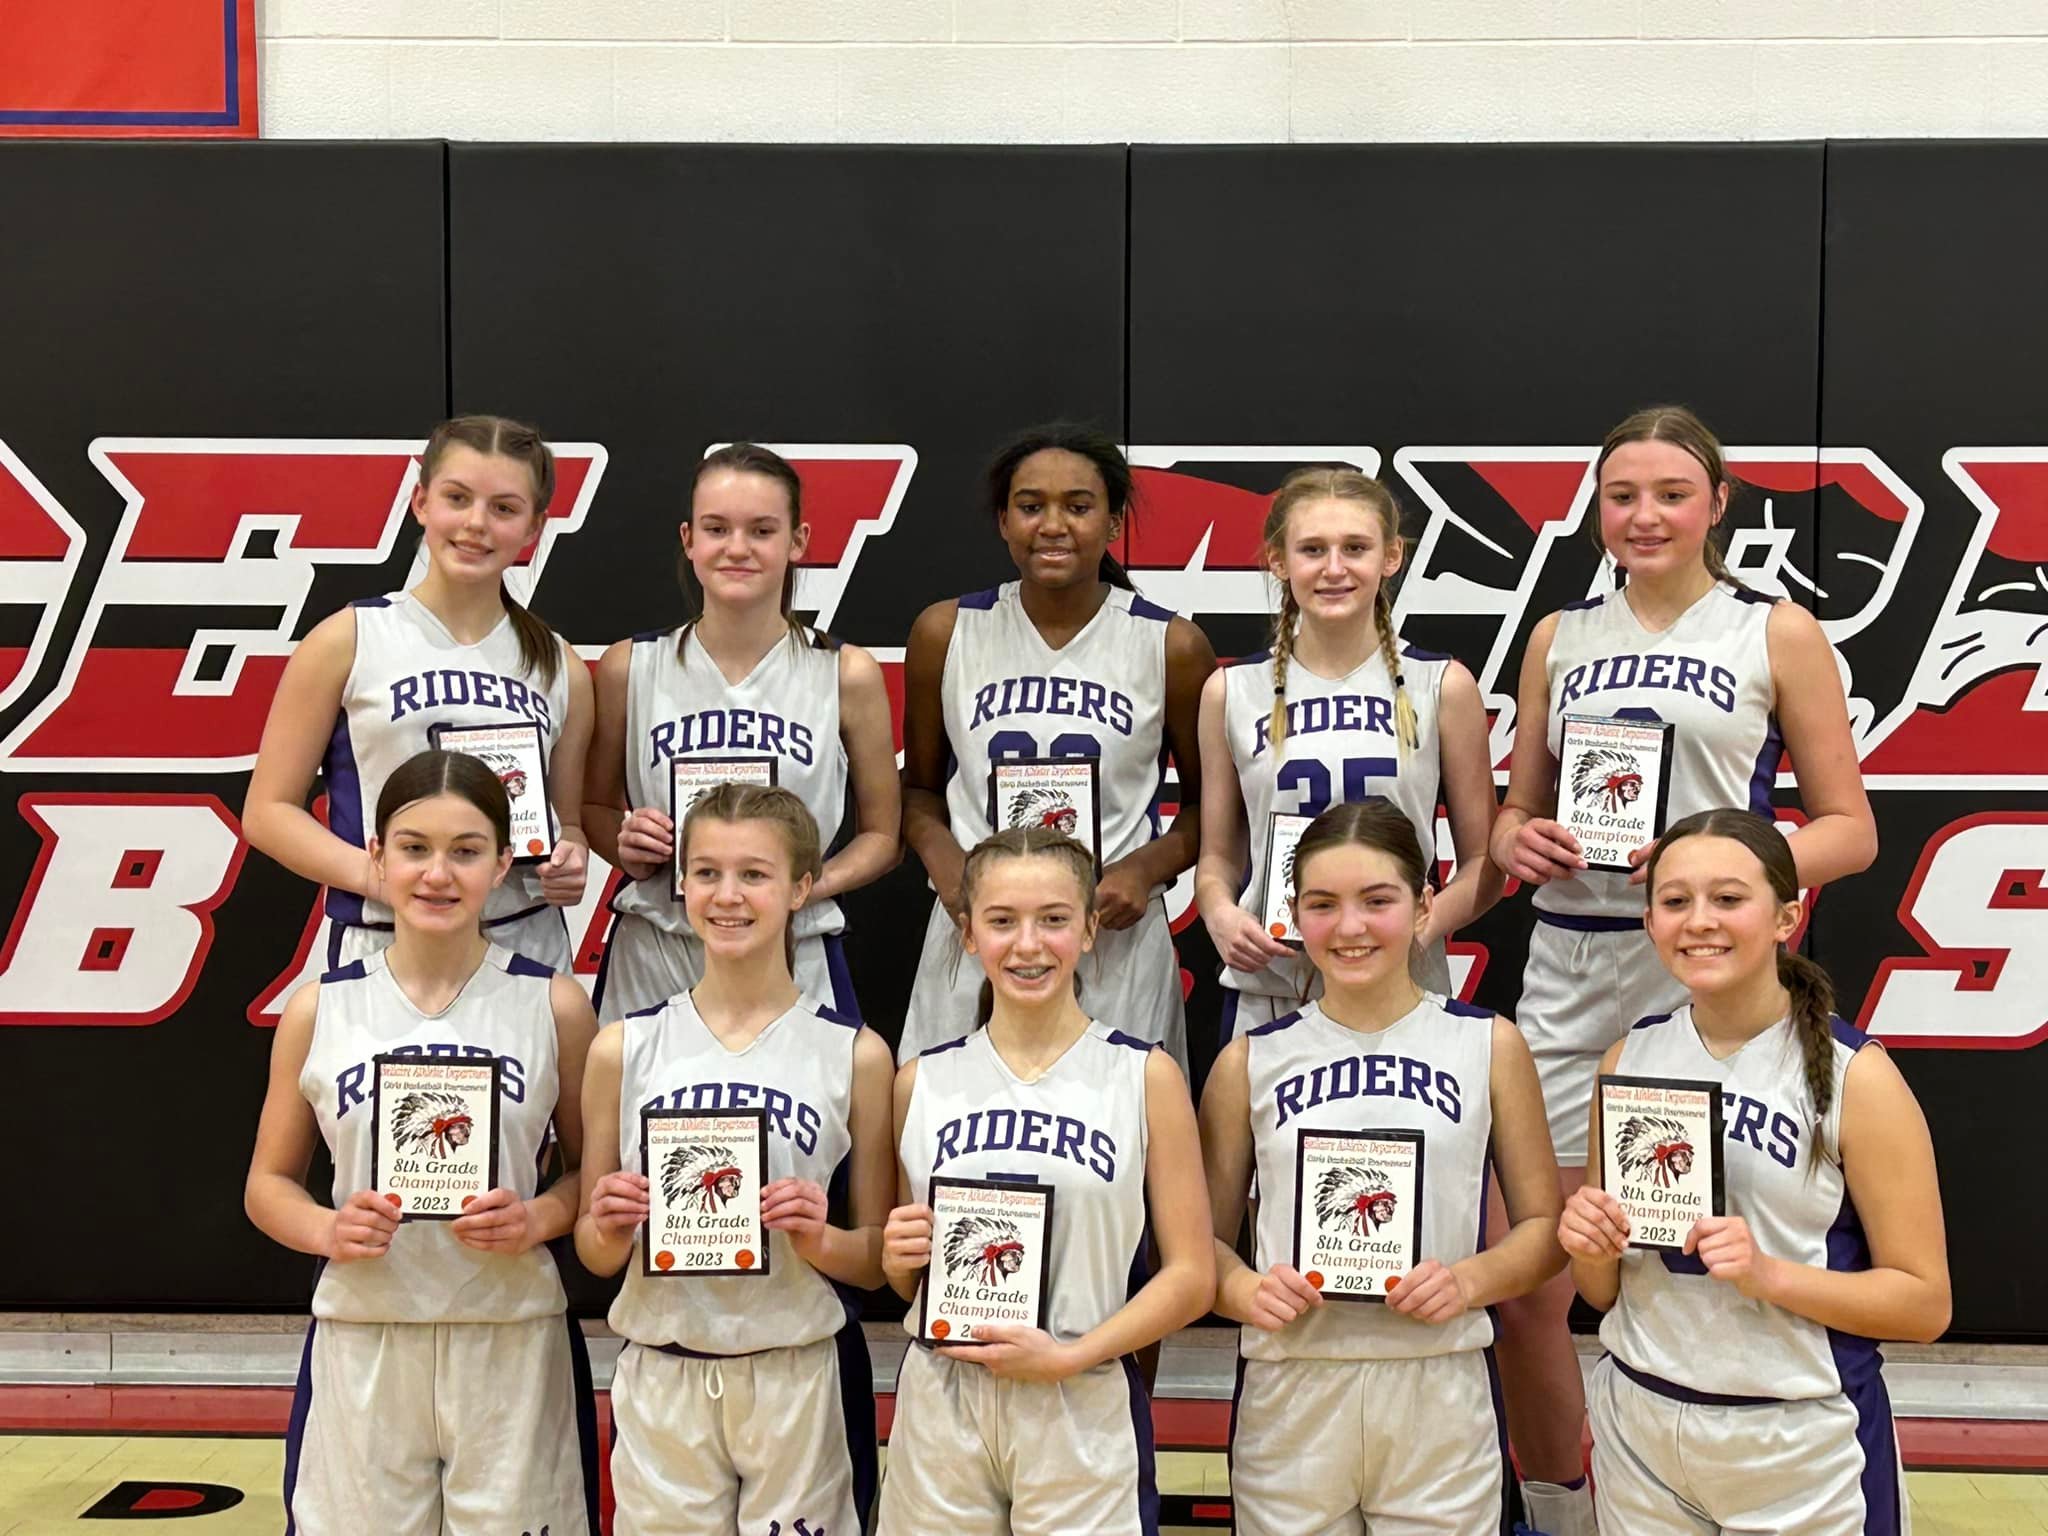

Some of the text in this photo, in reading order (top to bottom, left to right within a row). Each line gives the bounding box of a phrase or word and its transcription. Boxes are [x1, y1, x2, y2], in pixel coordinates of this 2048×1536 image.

[1557, 655, 1736, 714] RIDERS
[390, 669, 550, 735] RIDERS
[969, 676, 1133, 736] RIDERS
[1253, 695, 1419, 757] RIDER
[650, 709, 813, 769] RIDERS
[510, 809, 537, 821] ade
[1571, 810, 1645, 830] 8th Grade
[1567, 826, 1645, 845] Champions
[1584, 847, 1618, 861] 2023
[1275, 1054, 1461, 1130] RIDERS
[932, 1109, 1116, 1182] RIDERS
[394, 1158, 478, 1175] 8th Grade
[389, 1176, 480, 1191] Champions
[412, 1196, 449, 1210] 2023
[1620, 1185, 1701, 1205] 8th Grade
[665, 1215, 750, 1229] 8th Grade
[1618, 1203, 1703, 1222] Champions
[661, 1232, 752, 1247] Champions
[1640, 1226, 1676, 1241] 2023
[1316, 1235, 1401, 1254] 8th Grade
[685, 1252, 723, 1266] 2023
[1311, 1252, 1403, 1271] Champions
[1335, 1275, 1373, 1291] 2023
[944, 1283, 1028, 1304] 8th Grade
[938, 1302, 1029, 1321] Champions
